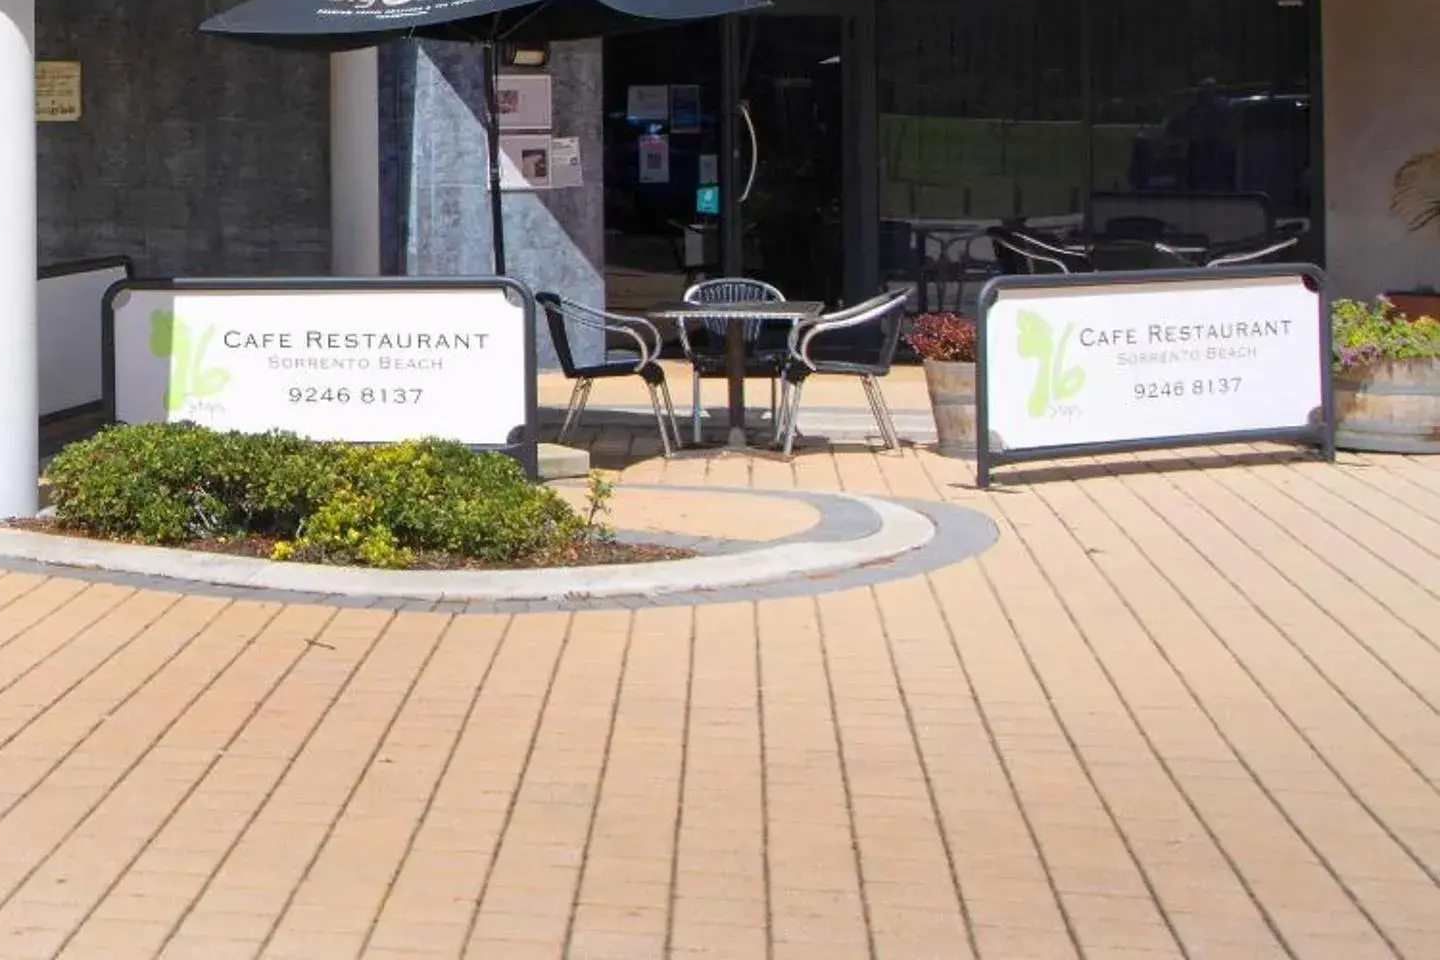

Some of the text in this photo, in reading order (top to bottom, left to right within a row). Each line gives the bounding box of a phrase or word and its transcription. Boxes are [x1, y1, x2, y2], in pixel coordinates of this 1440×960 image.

[224, 330, 489, 349] CAFE RESTAURANT
[1080, 320, 1292, 347] CAFE RESTAURANT
[268, 356, 443, 370] SORRENTO BEACH
[1116, 345, 1257, 366] SORRENTO BEACH
[288, 386, 423, 404] 9246 8137
[1134, 377, 1242, 399] 9246 8137
